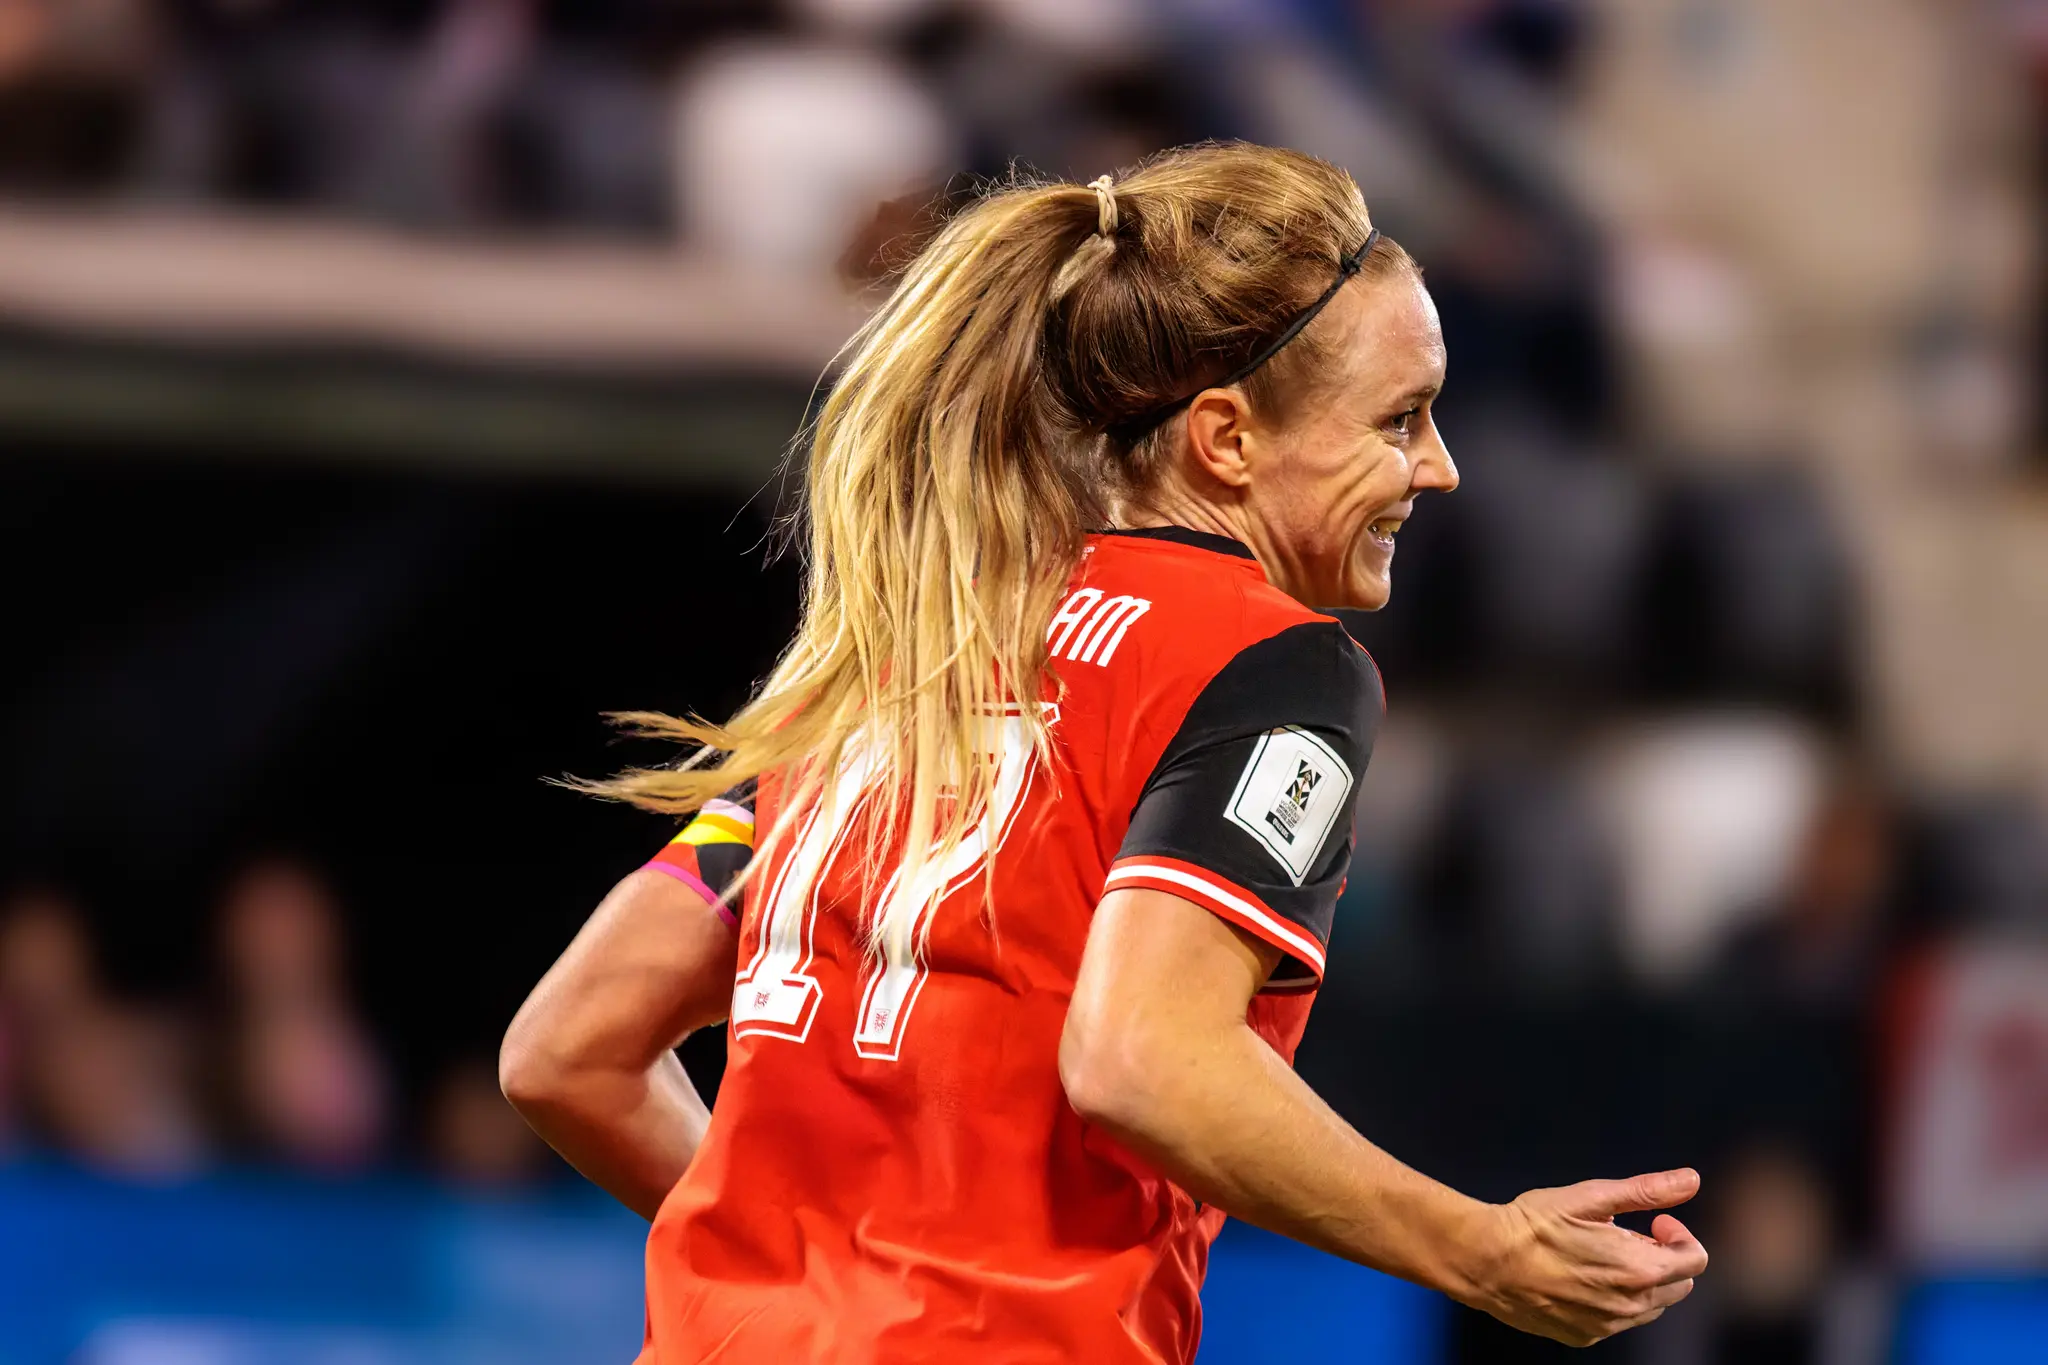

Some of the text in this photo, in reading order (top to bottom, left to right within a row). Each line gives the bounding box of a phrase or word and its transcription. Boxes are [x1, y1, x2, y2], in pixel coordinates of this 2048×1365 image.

[1046, 588, 1152, 667] AM
[1279, 804, 1291, 817] WORLD
[732, 702, 1061, 1061] 17
